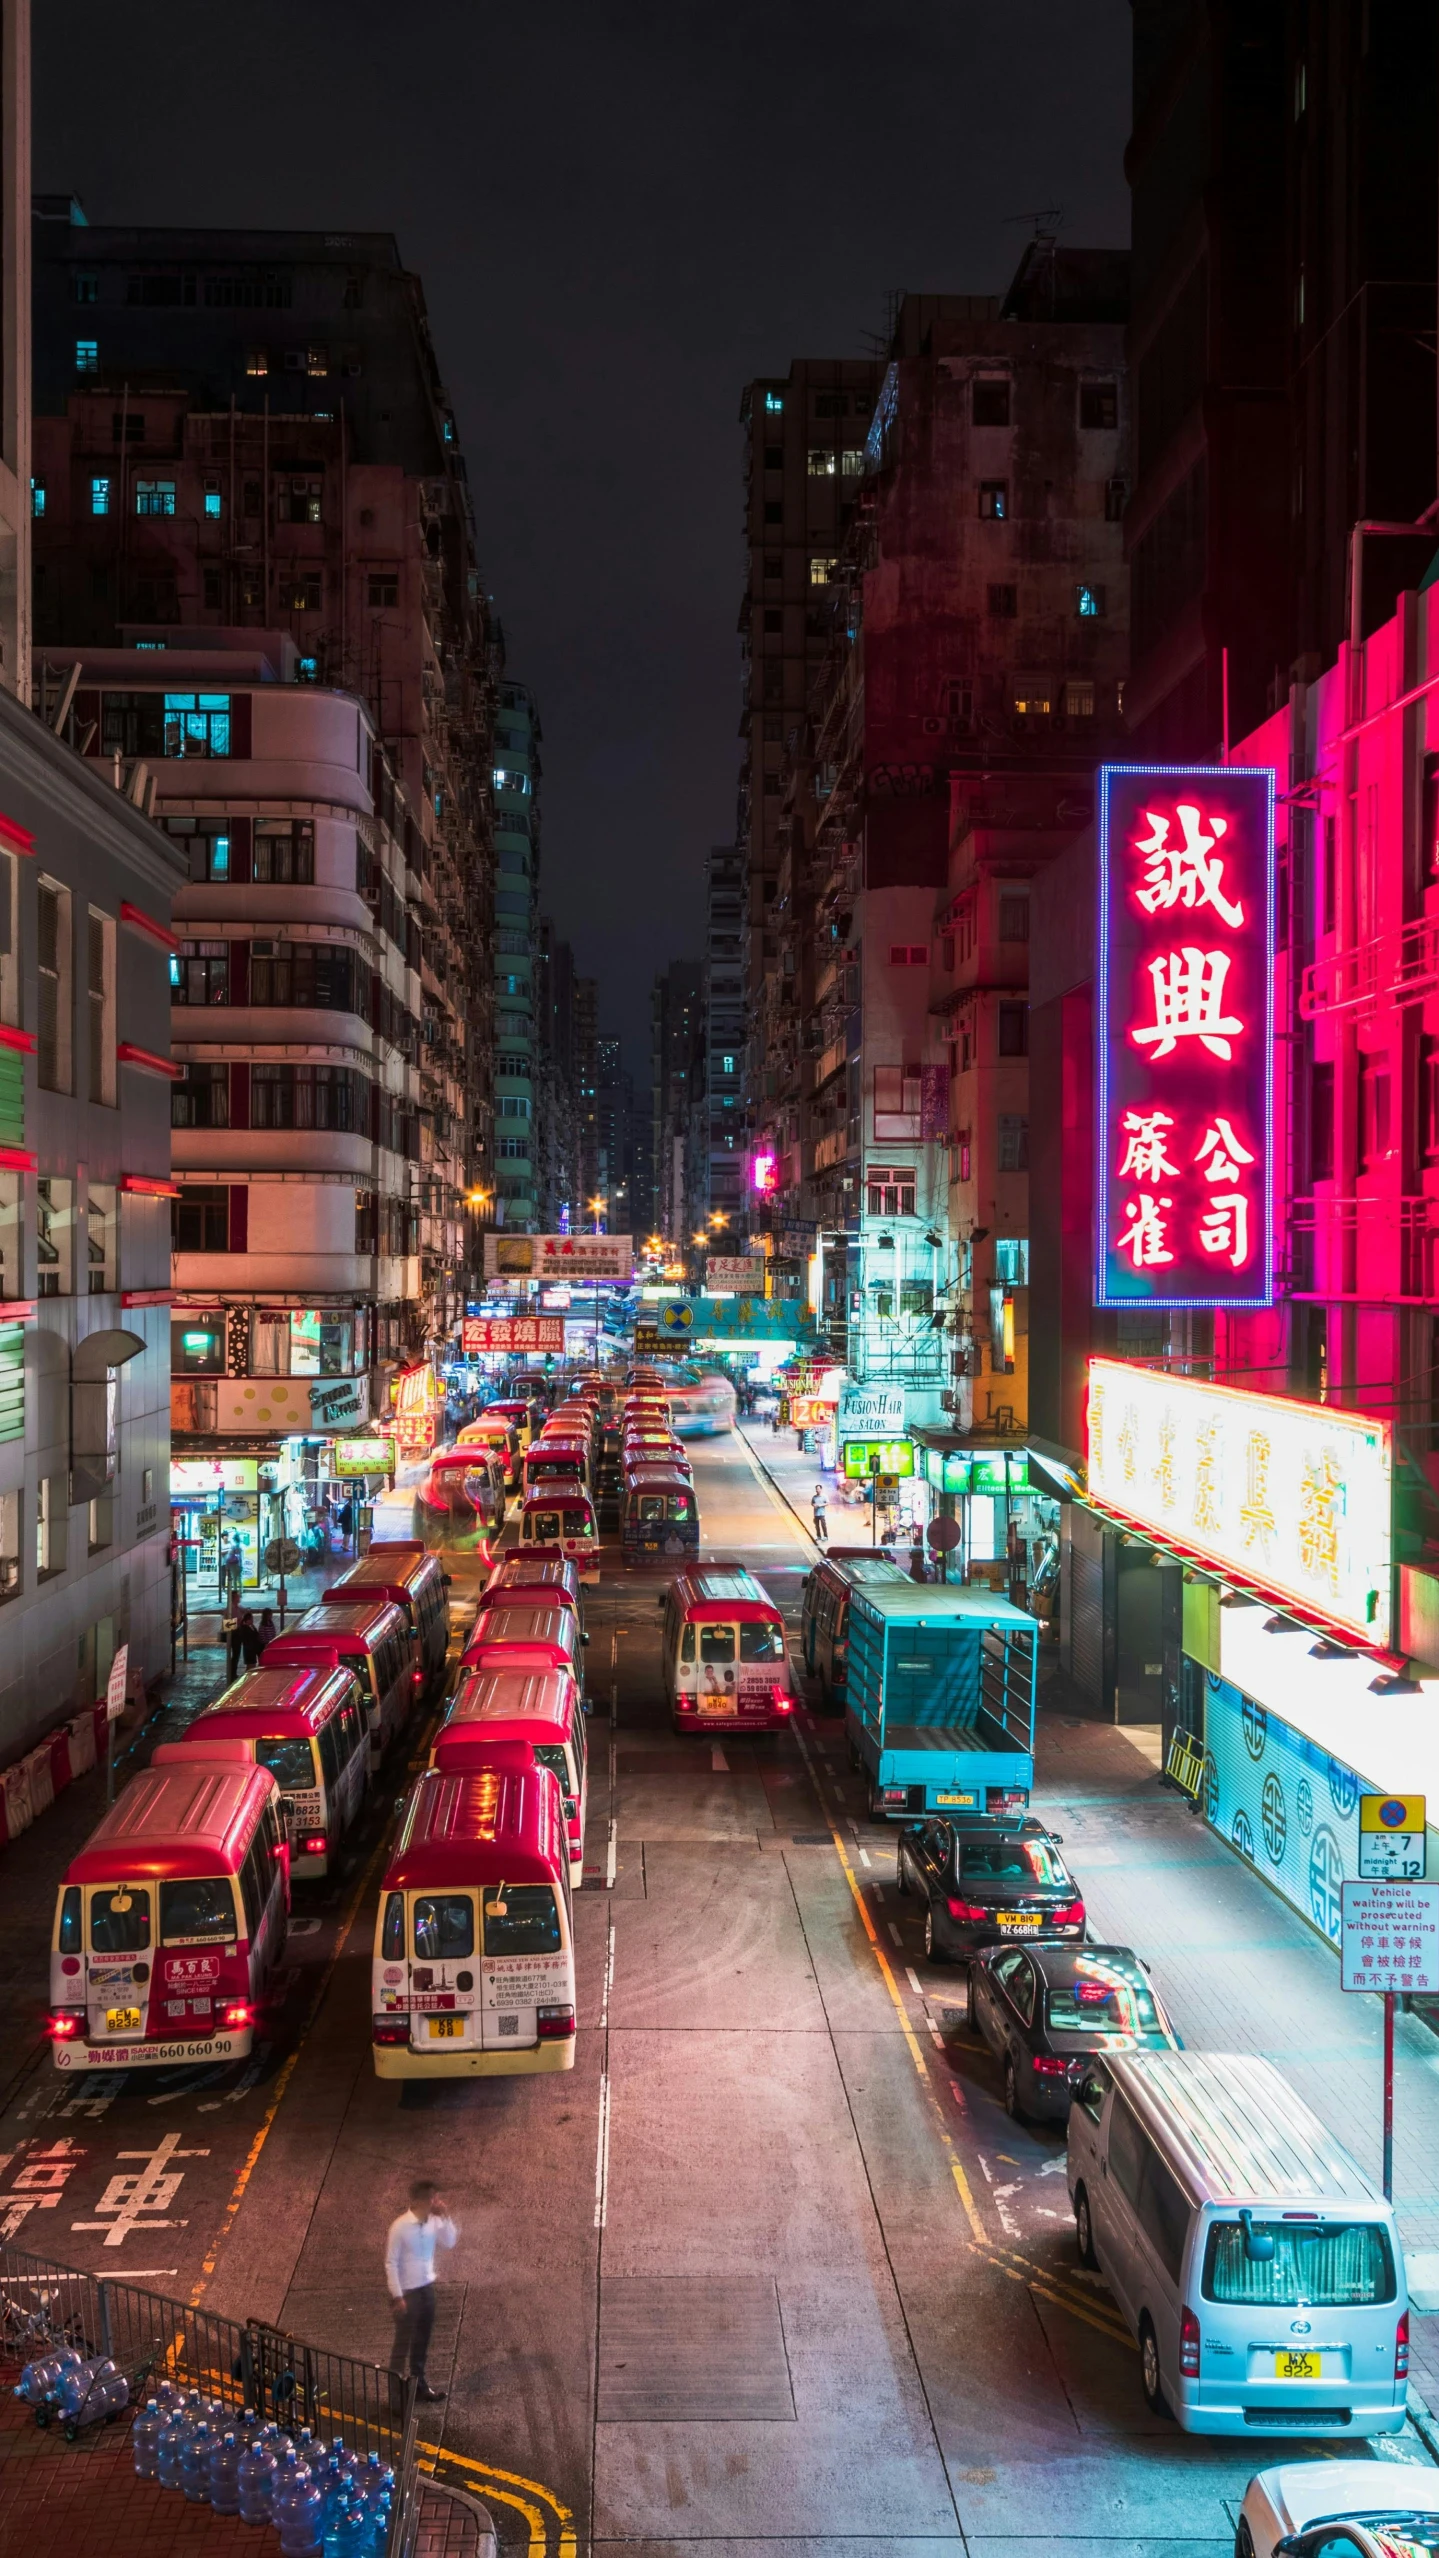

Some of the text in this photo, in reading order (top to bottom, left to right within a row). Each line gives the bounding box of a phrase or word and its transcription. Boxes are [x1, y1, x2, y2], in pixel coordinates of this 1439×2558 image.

[1132, 804, 1245, 1060] 誠興
[1194, 1118, 1255, 1267] 公司
[465, 1319, 561, 1342] 宏發燒臘
[859, 1419, 886, 1430] SALON
[339, 1442, 392, 1460] 海天堂
[296, 1805, 321, 1815] 6823
[296, 1816, 321, 1826] 3153
[1371, 1841, 1391, 1850] 上午
[1401, 1836, 1411, 1850] 7
[1363, 1858, 1397, 1866] midnight
[1371, 1866, 1390, 1875] 午夜
[1402, 1861, 1420, 1876] 12
[1371, 1887, 1411, 1897] Vehicle
[1352, 1899, 1430, 1909] waiting will be
[1360, 1910, 1422, 1920] prosecuted
[1347, 1922, 1436, 1933] without warning
[1361, 1936, 1422, 1950] 停車等候
[1361, 1954, 1422, 1968] 會被檢控
[171, 1960, 212, 1975] 馬百良
[1353, 1973, 1429, 1987] 而不予警告
[116, 2010, 132, 2019] FM
[108, 2018, 139, 2028] 8232
[438, 2019, 453, 2028] KR
[438, 2027, 454, 2037] 98
[160, 2044, 185, 2058] 660
[187, 2042, 212, 2055] 660
[215, 2040, 232, 2053] 90
[1288, 2353, 1308, 2365] MX
[1283, 2365, 1313, 2378] 922
